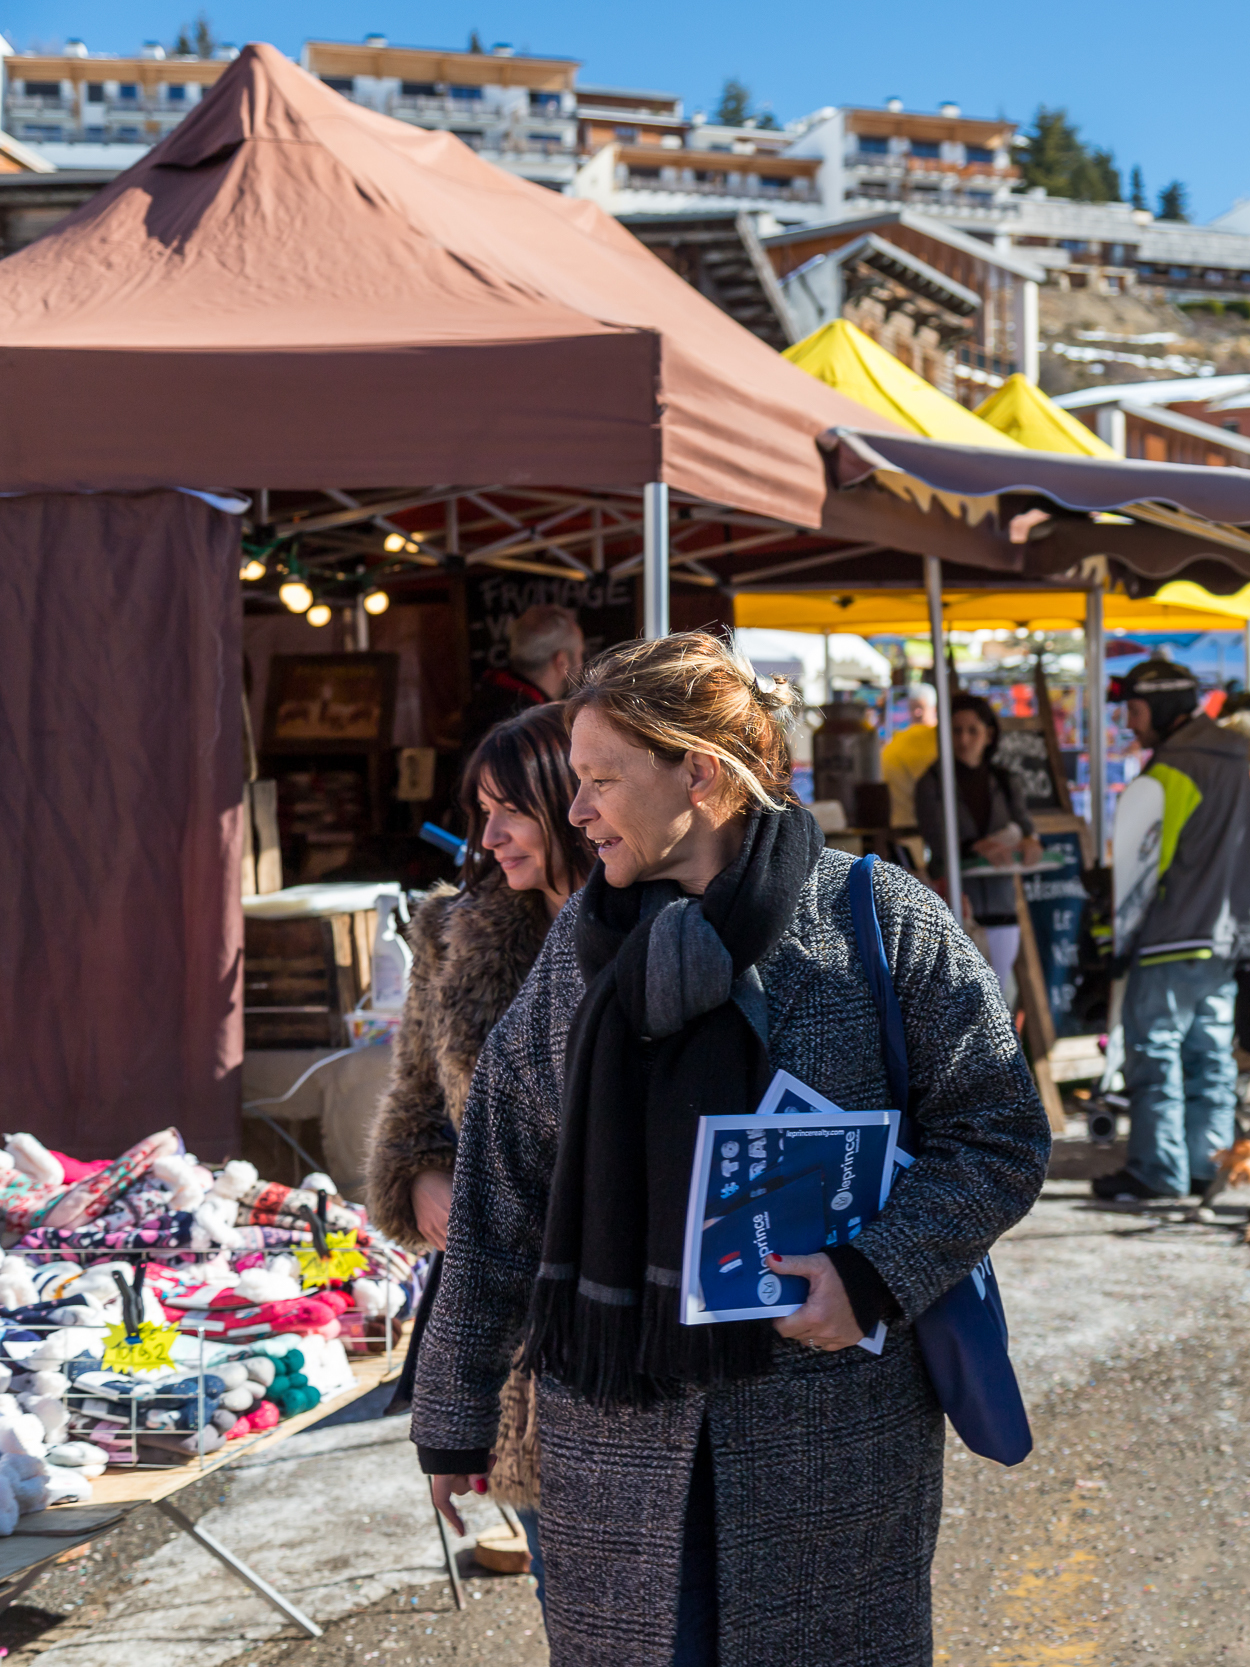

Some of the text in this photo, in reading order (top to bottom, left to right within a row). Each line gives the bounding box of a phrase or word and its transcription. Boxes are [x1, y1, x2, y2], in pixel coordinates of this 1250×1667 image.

[480, 577, 633, 609] FROMAGE
[836, 1130, 857, 1192] leprince
[752, 1213, 774, 1275] leprince
